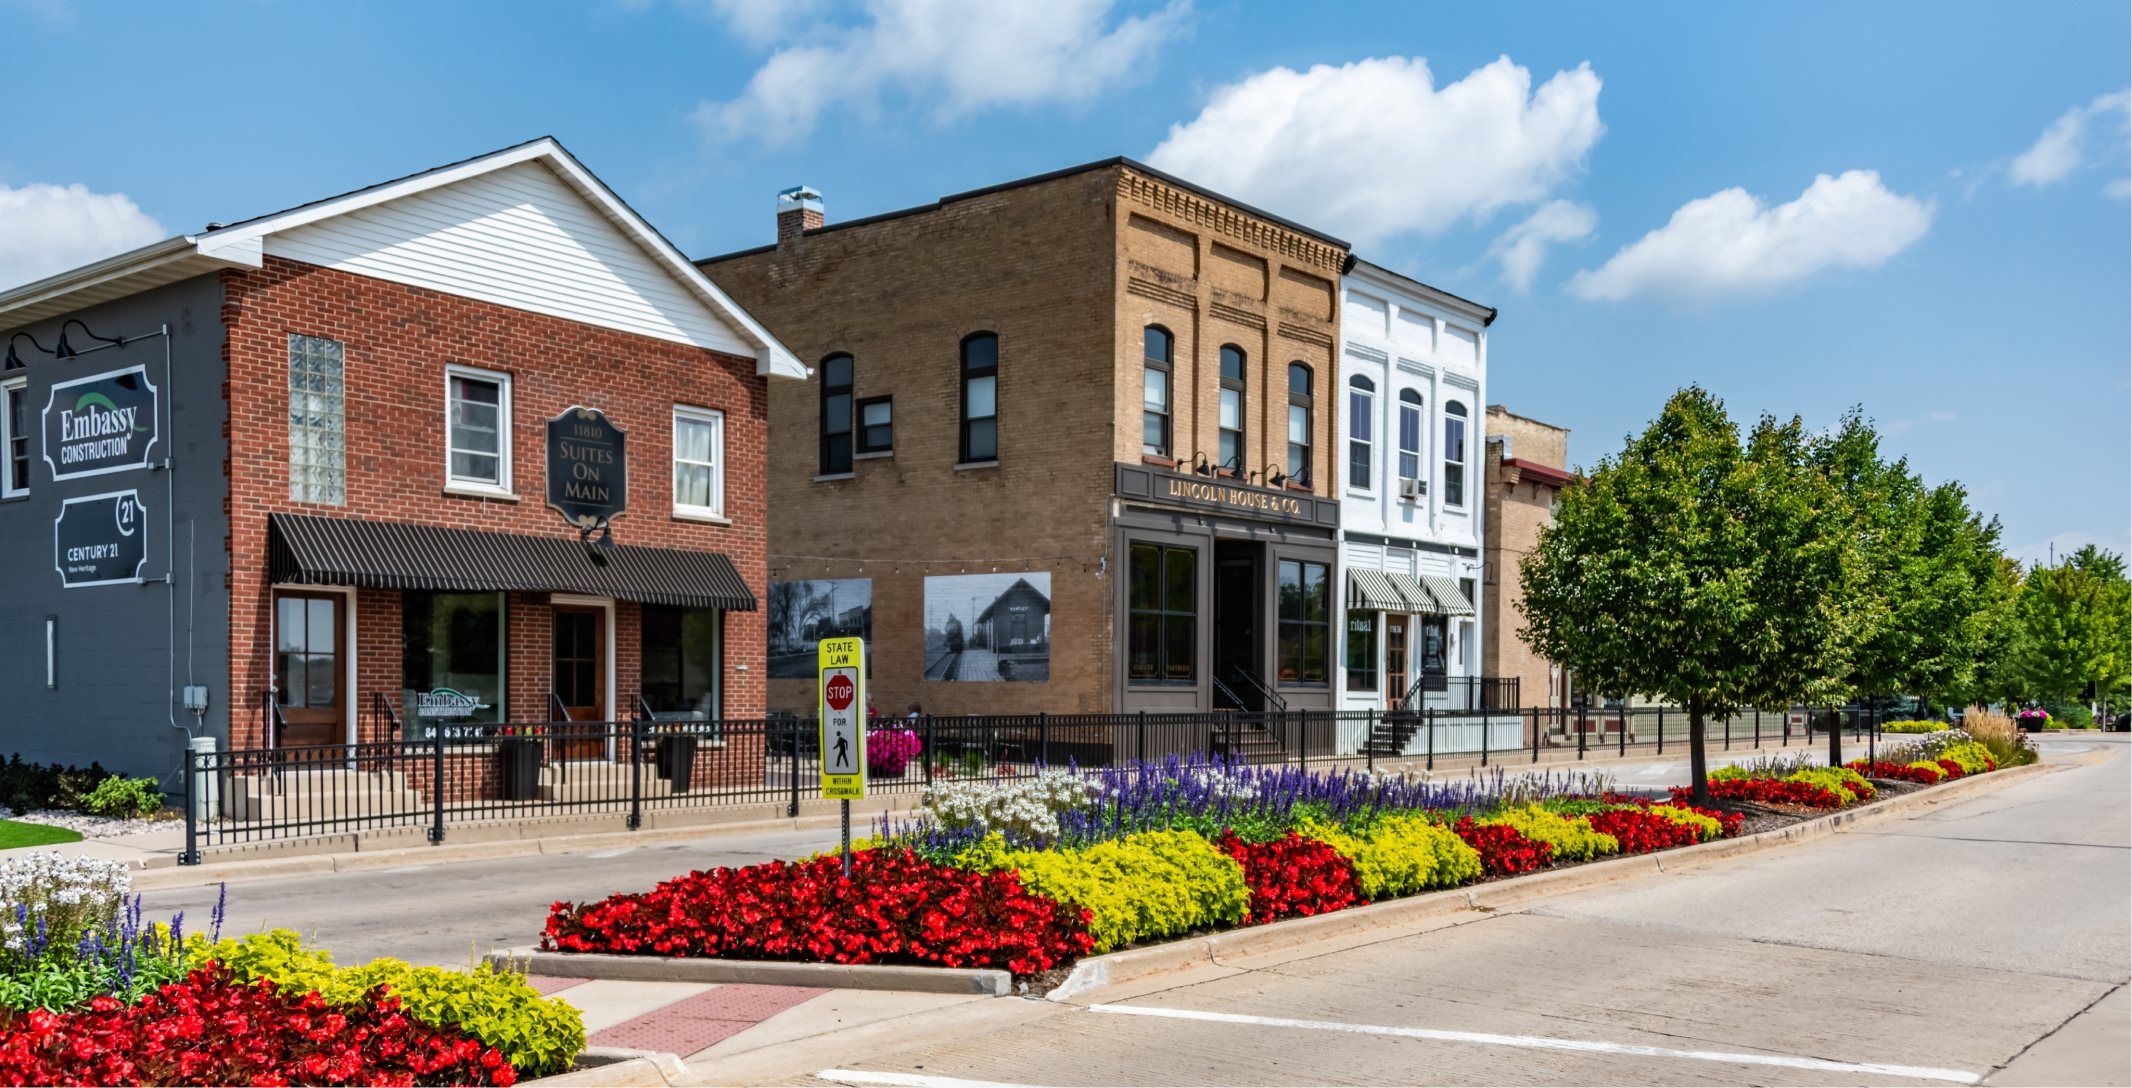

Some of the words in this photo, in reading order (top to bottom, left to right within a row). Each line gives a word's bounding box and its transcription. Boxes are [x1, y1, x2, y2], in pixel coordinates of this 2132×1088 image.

[60, 405, 138, 442] Embassy
[574, 424, 602, 439] 11810
[61, 436, 127, 464] CONSTRUCTION
[560, 441, 613, 464] SUITES
[573, 462, 599, 480] ON
[565, 480, 609, 501] MAIN
[1169, 480, 1225, 502] LINCOLN
[1230, 489, 1268, 509] HOUSE
[1271, 496, 1280, 511] &
[1282, 498, 1301, 514] CO.
[121, 500, 134, 523] 21
[67, 544, 109, 562] CENTURY
[109, 543, 119, 558] 21
[1350, 620, 1371, 632] ritual
[826, 641, 853, 653] STATE
[830, 654, 849, 665] LAW
[417, 692, 480, 711] Embassy
[827, 685, 853, 700] STOP
[832, 718, 847, 727] FOR
[831, 777, 852, 785] WITHIN
[825, 786, 861, 796] CROSSWALK
